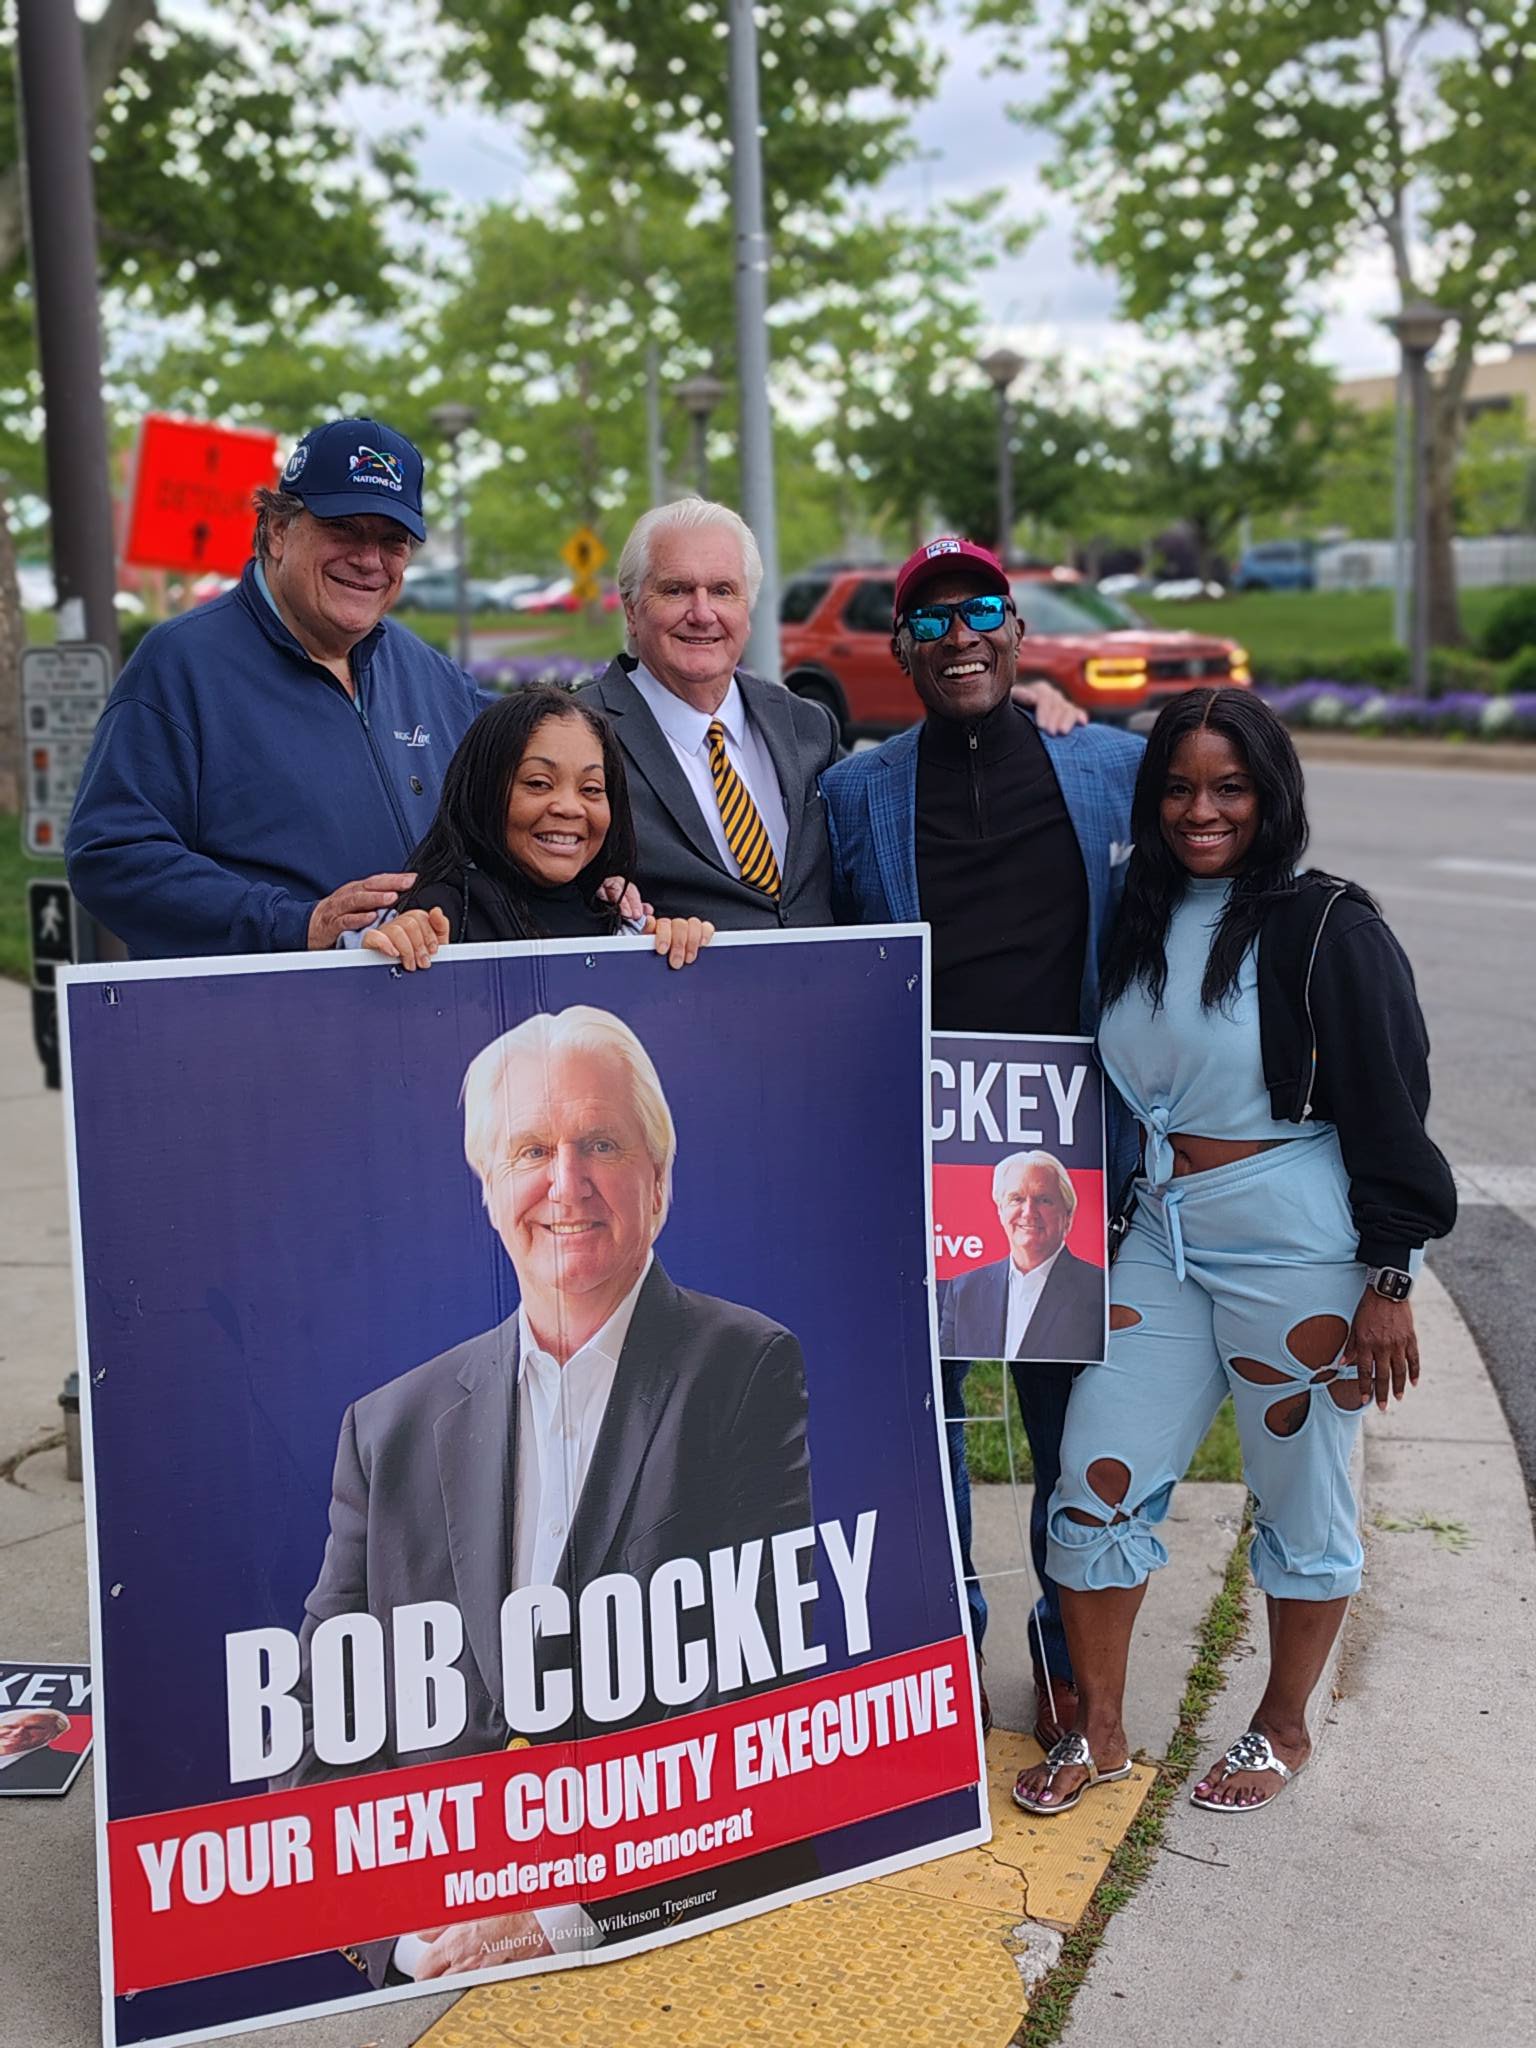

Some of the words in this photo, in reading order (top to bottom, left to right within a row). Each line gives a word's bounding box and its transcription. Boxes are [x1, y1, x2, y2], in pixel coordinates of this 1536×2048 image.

[353, 475, 389, 487] NATIONS
[390, 481, 402, 491] CUP
[930, 1059, 1088, 1145] CKEY
[933, 1224, 984, 1258] ive
[225, 1600, 468, 1784] BOB
[500, 1509, 878, 1733] COCKEY
[136, 1815, 314, 1912] YOUR
[334, 1781, 483, 1875] NEXT
[504, 1733, 718, 1842] COUNTY
[733, 1664, 958, 1790] EXECUTIVE
[444, 1852, 607, 1907] Moderate
[615, 1808, 754, 1876] Democrat
[478, 1930, 547, 1955] Authority
[549, 1923, 594, 1942] Javina
[597, 1905, 660, 1933] Wilkinson
[662, 1887, 718, 1915] Treasurer
